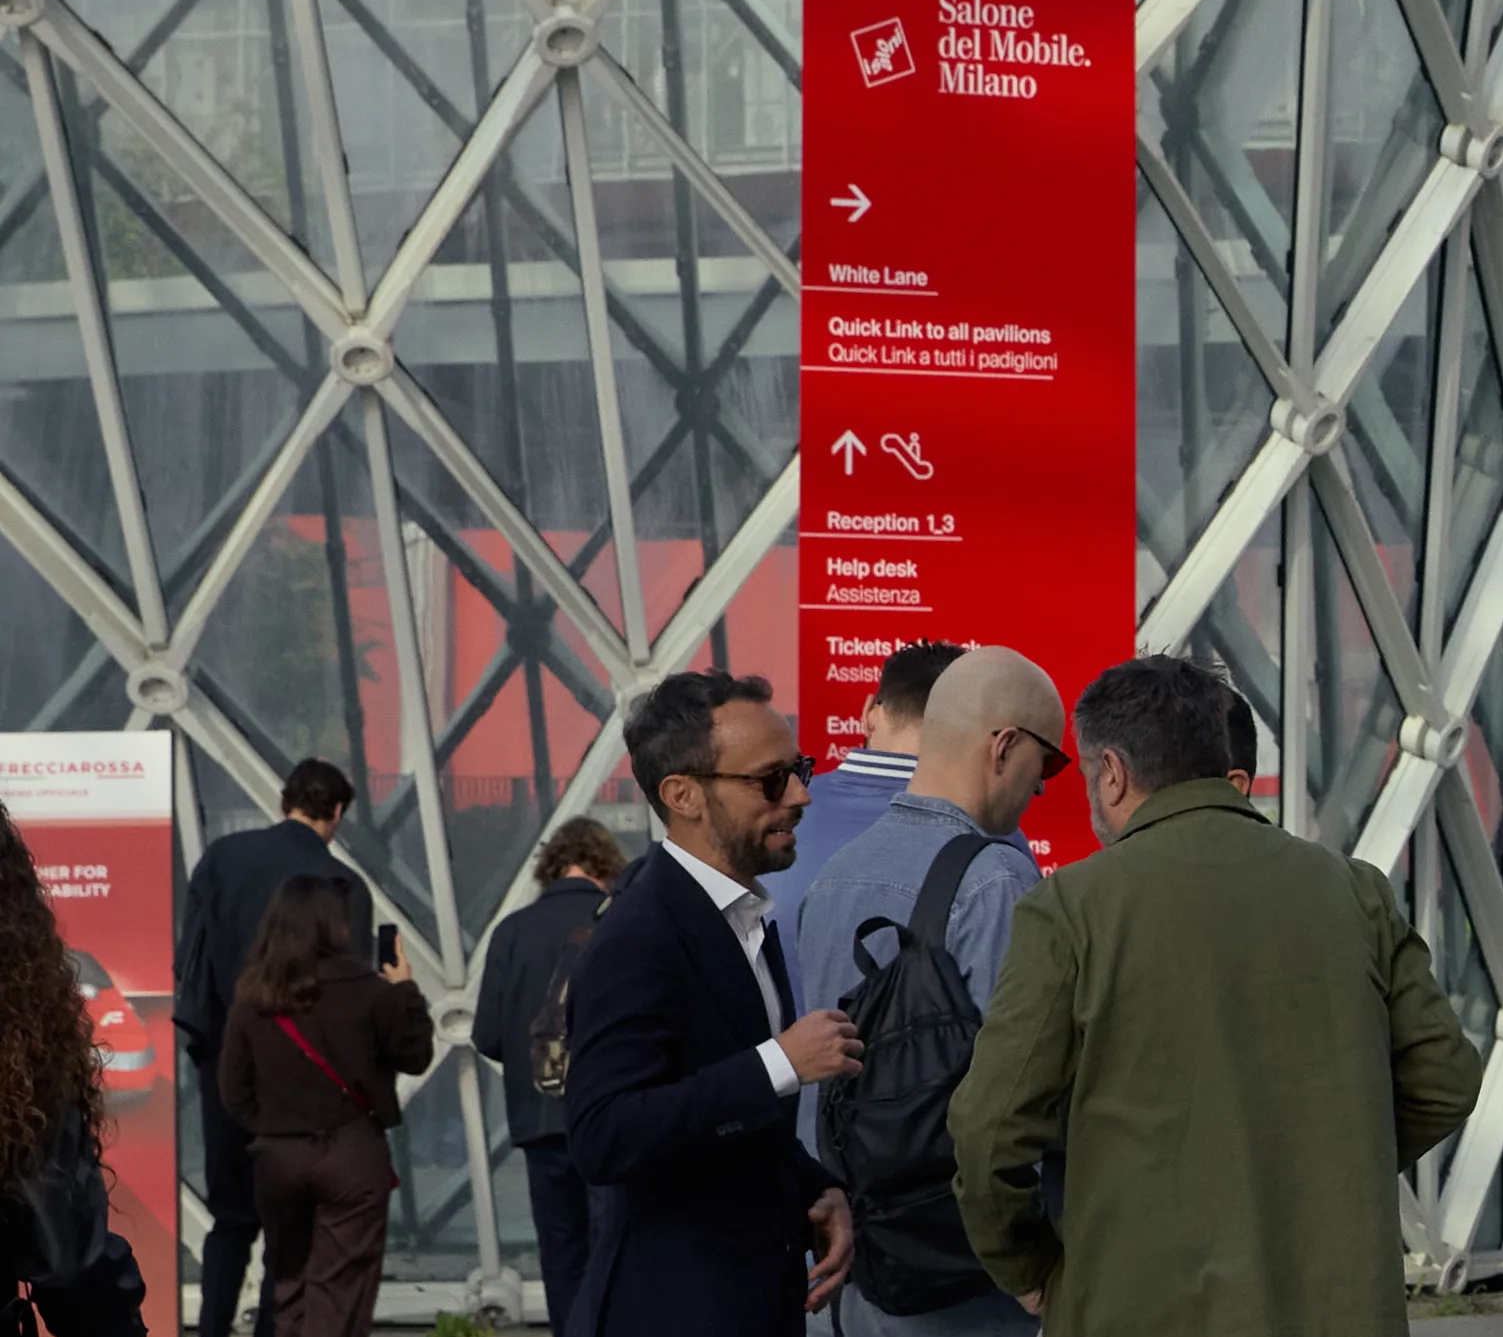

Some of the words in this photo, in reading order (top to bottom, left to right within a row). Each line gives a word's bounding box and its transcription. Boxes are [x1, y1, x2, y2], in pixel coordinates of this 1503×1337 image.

[938, 27, 982, 61] del
[989, 30, 1091, 67] Mobile.
[938, 61, 1037, 99] Milano
[829, 264, 880, 284] White
[884, 266, 928, 286] Lane
[829, 317, 881, 338] Quick
[885, 319, 922, 339] Link
[926, 321, 945, 339] to
[948, 322, 969, 341] all
[973, 323, 1051, 344] pavilions
[829, 344, 878, 364] Quick
[882, 345, 916, 365] Link
[919, 352, 930, 365] a
[933, 349, 966, 367] tutti
[979, 351, 1057, 373] padiglioni
[827, 511, 919, 533] Reception
[827, 558, 870, 579] Help
[874, 560, 917, 578] desk
[826, 584, 920, 604] Assistenza
[827, 637, 891, 656] Tickets
[73, 865, 108, 879] FOR
[50, 884, 111, 897] ABILITY
